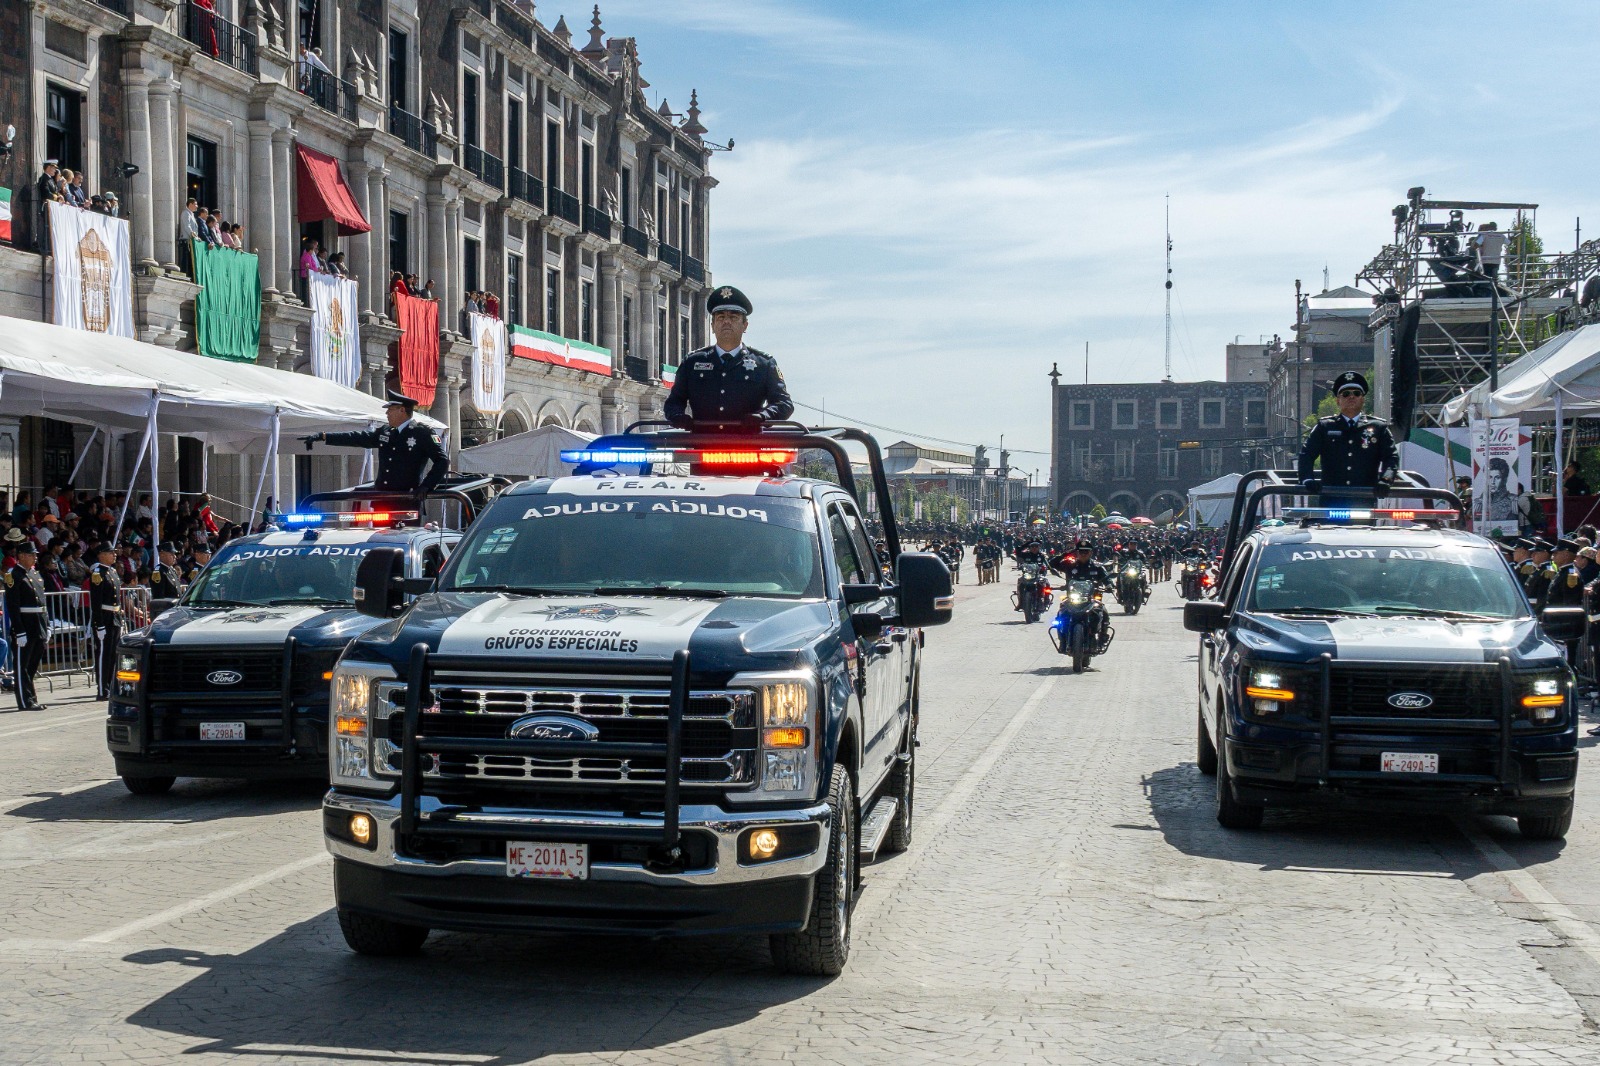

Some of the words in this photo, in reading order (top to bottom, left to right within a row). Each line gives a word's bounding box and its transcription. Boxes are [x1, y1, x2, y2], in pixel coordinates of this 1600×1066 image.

[485, 637, 544, 650] GRUPOS
[548, 637, 638, 653] ESPECIALES
[213, 672, 236, 683] Ford
[1396, 694, 1425, 707] Ford
[1383, 760, 1436, 773] ME-249A-5
[509, 847, 584, 866] ME-201A-5
